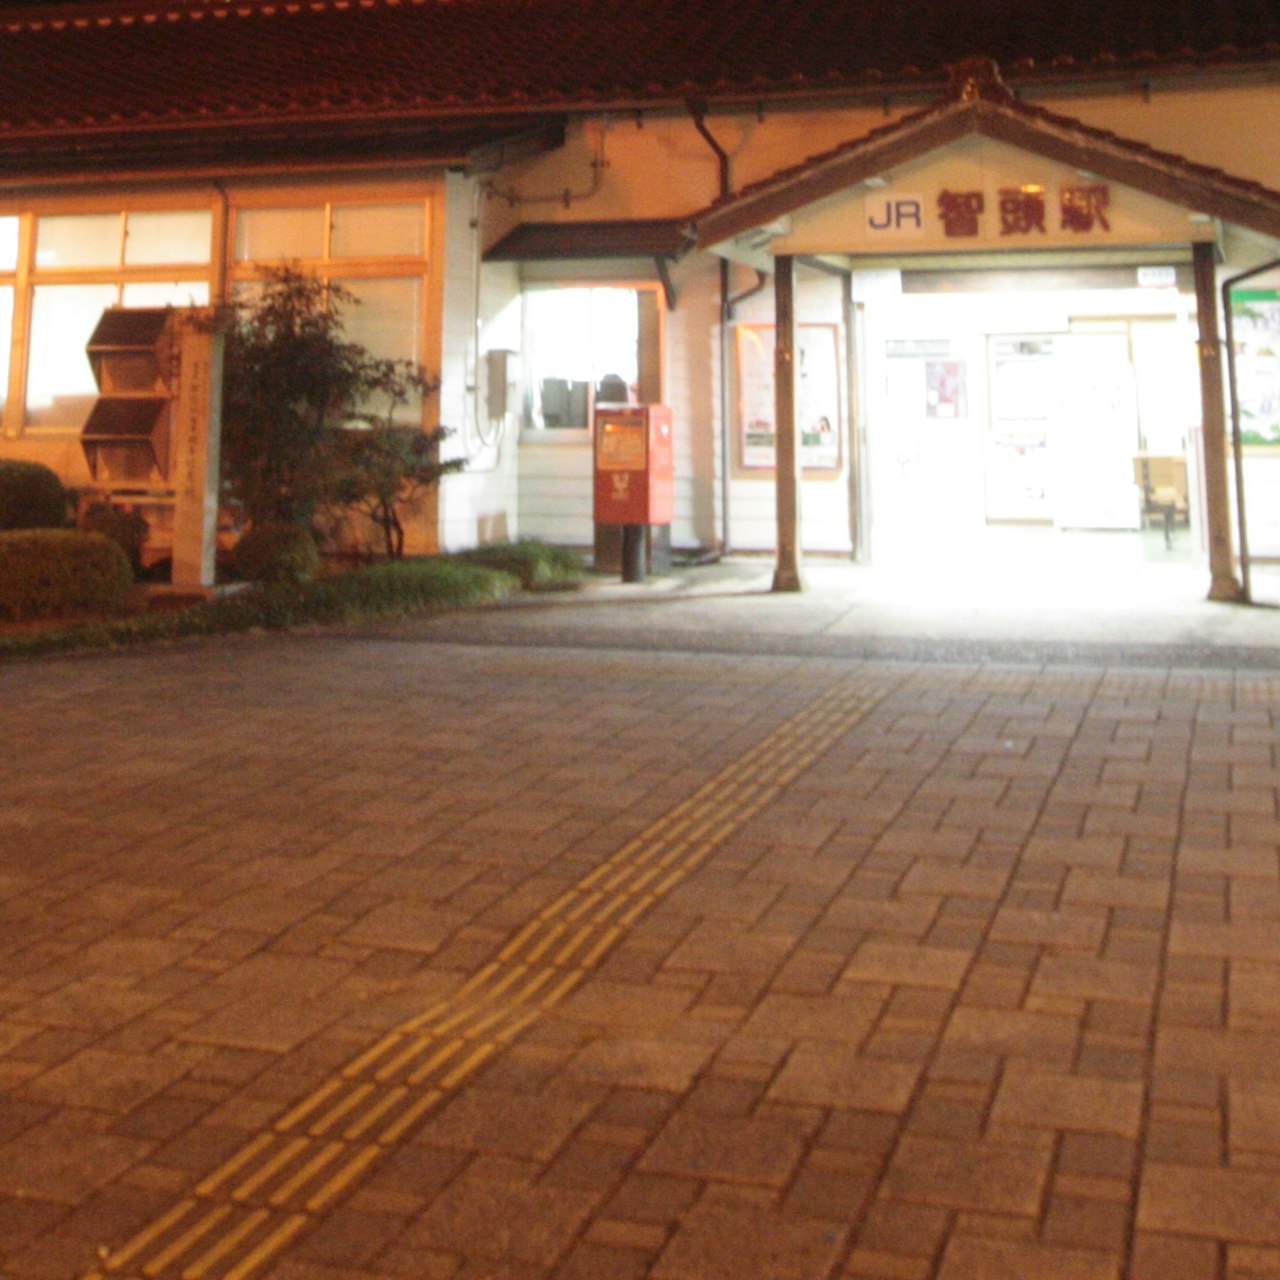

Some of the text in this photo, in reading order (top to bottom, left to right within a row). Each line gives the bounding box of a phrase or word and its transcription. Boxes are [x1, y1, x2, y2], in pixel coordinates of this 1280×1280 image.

[868, 184, 1111, 238] JR 智頭駅
